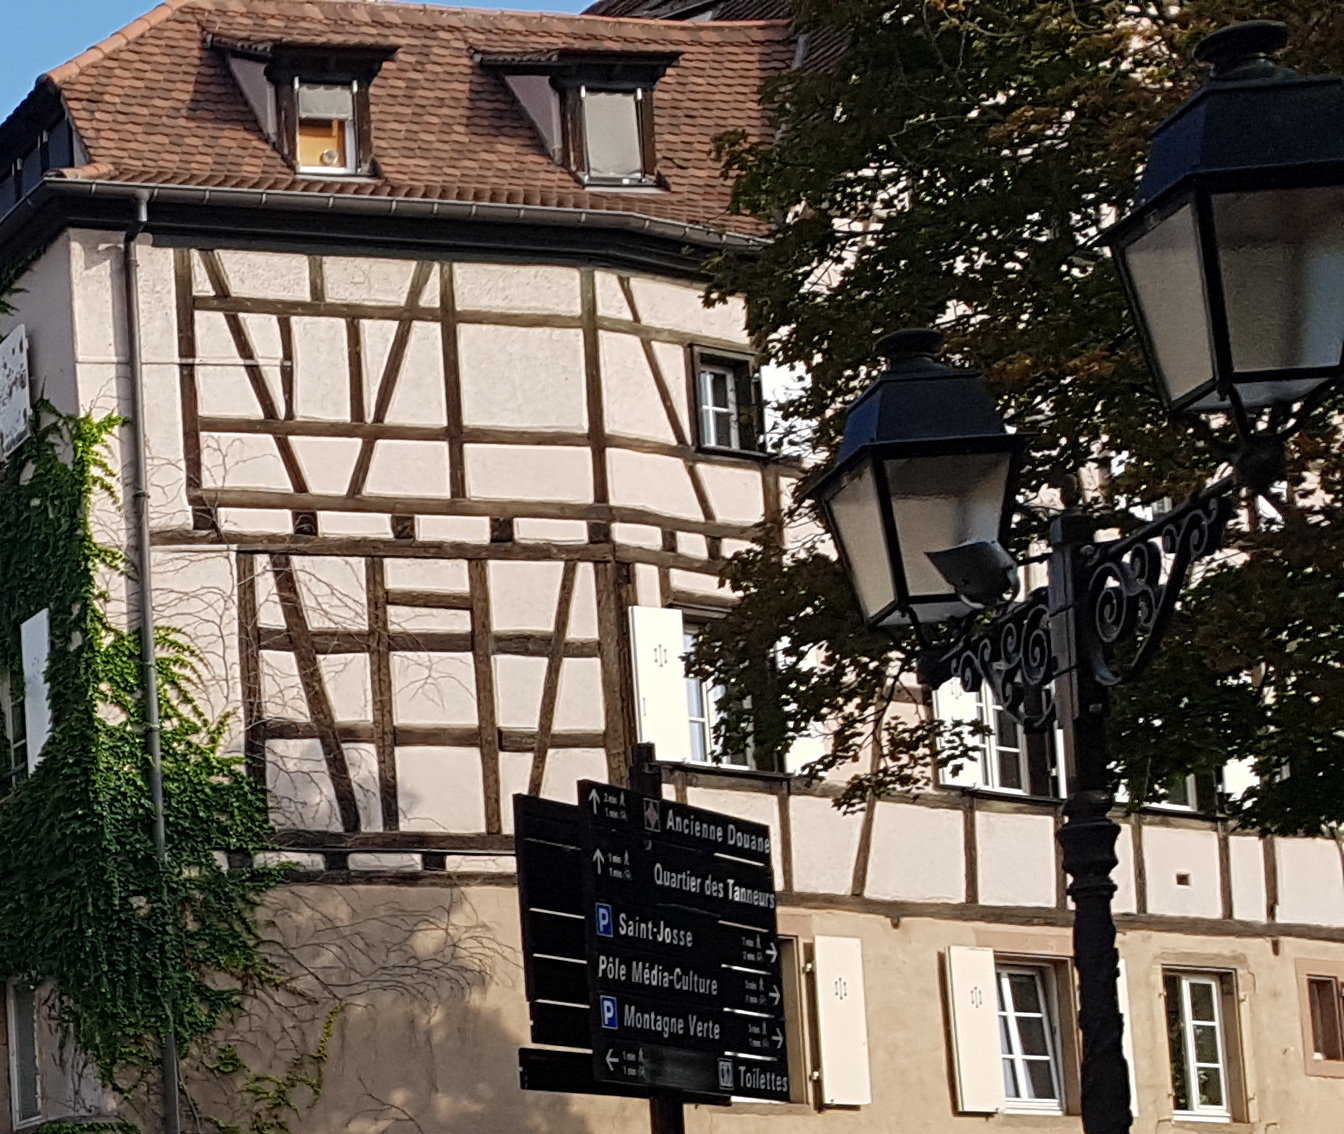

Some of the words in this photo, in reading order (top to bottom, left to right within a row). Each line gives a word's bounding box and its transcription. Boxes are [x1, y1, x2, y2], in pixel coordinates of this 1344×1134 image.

[666, 809, 724, 843] Ancienne
[727, 824, 771, 854] Douane
[653, 862, 701, 894] Quartier
[704, 873, 724, 899] des
[726, 879, 775, 909] Tanneurs
[598, 907, 609, 933] P
[618, 912, 693, 947] Saint-Josse
[598, 955, 627, 981] Pôle
[632, 960, 718, 996] Média-Culture
[603, 1000, 614, 1025] P
[623, 1004, 685, 1039] Montagne
[688, 1013, 721, 1040] Verte
[737, 1065, 788, 1092] Toilettes
